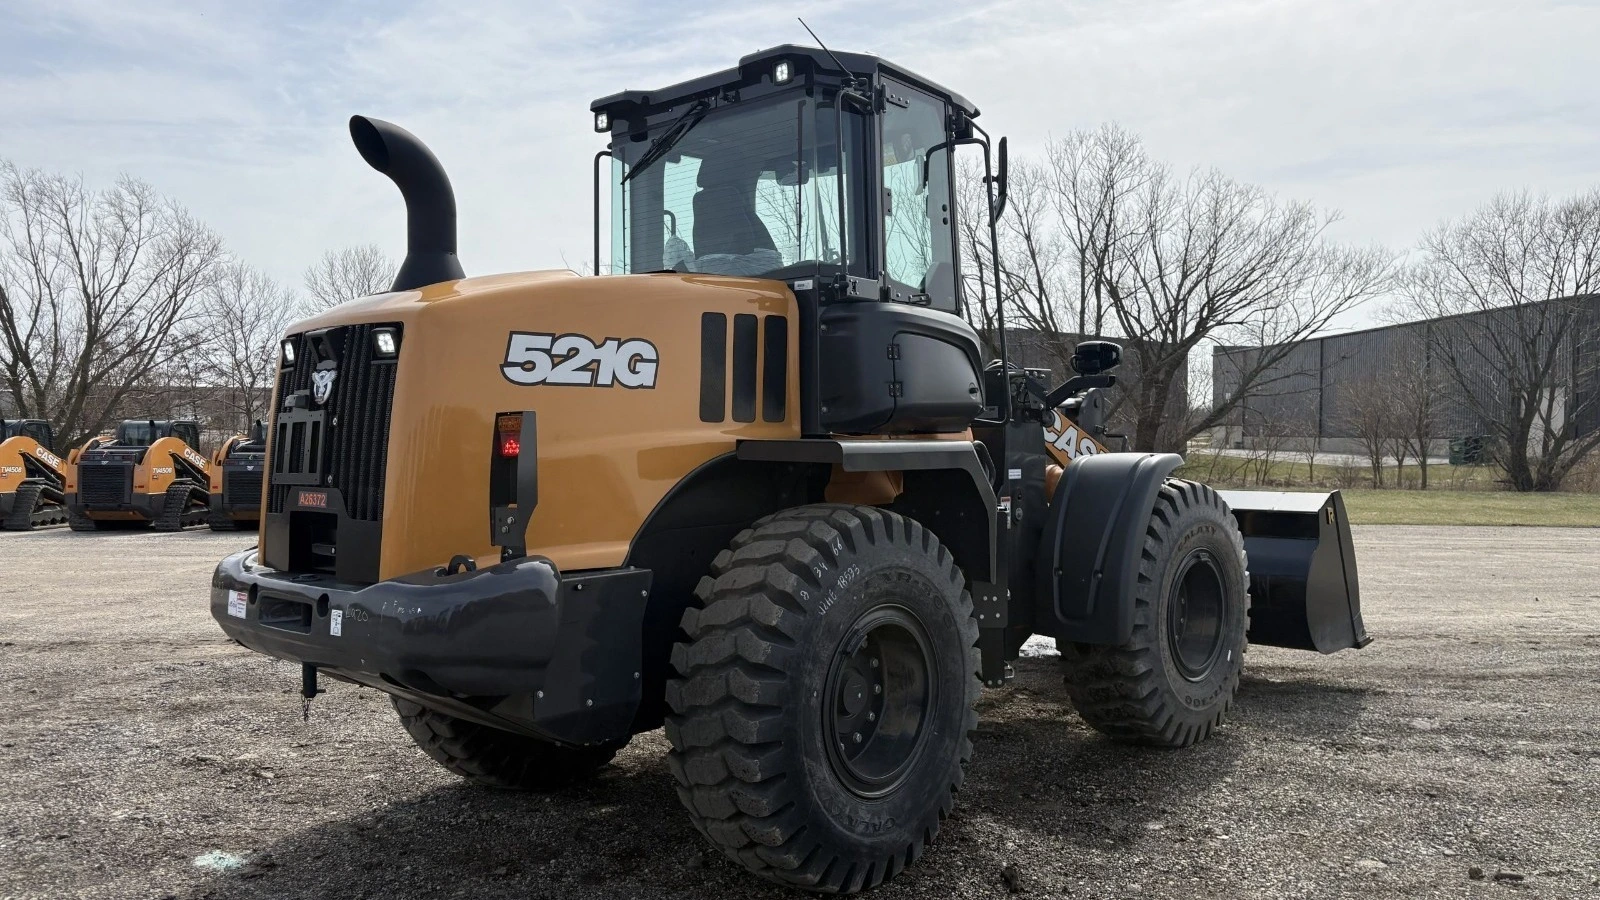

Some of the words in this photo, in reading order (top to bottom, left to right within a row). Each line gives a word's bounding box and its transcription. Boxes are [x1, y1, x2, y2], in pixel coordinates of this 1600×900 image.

[499, 331, 660, 389] 521G
[1043, 409, 1107, 460] CAS
[36, 447, 60, 469] CASE
[184, 447, 206, 469] CASE
[300, 492, 326, 506] A26372
[832, 537, 842, 556] 66
